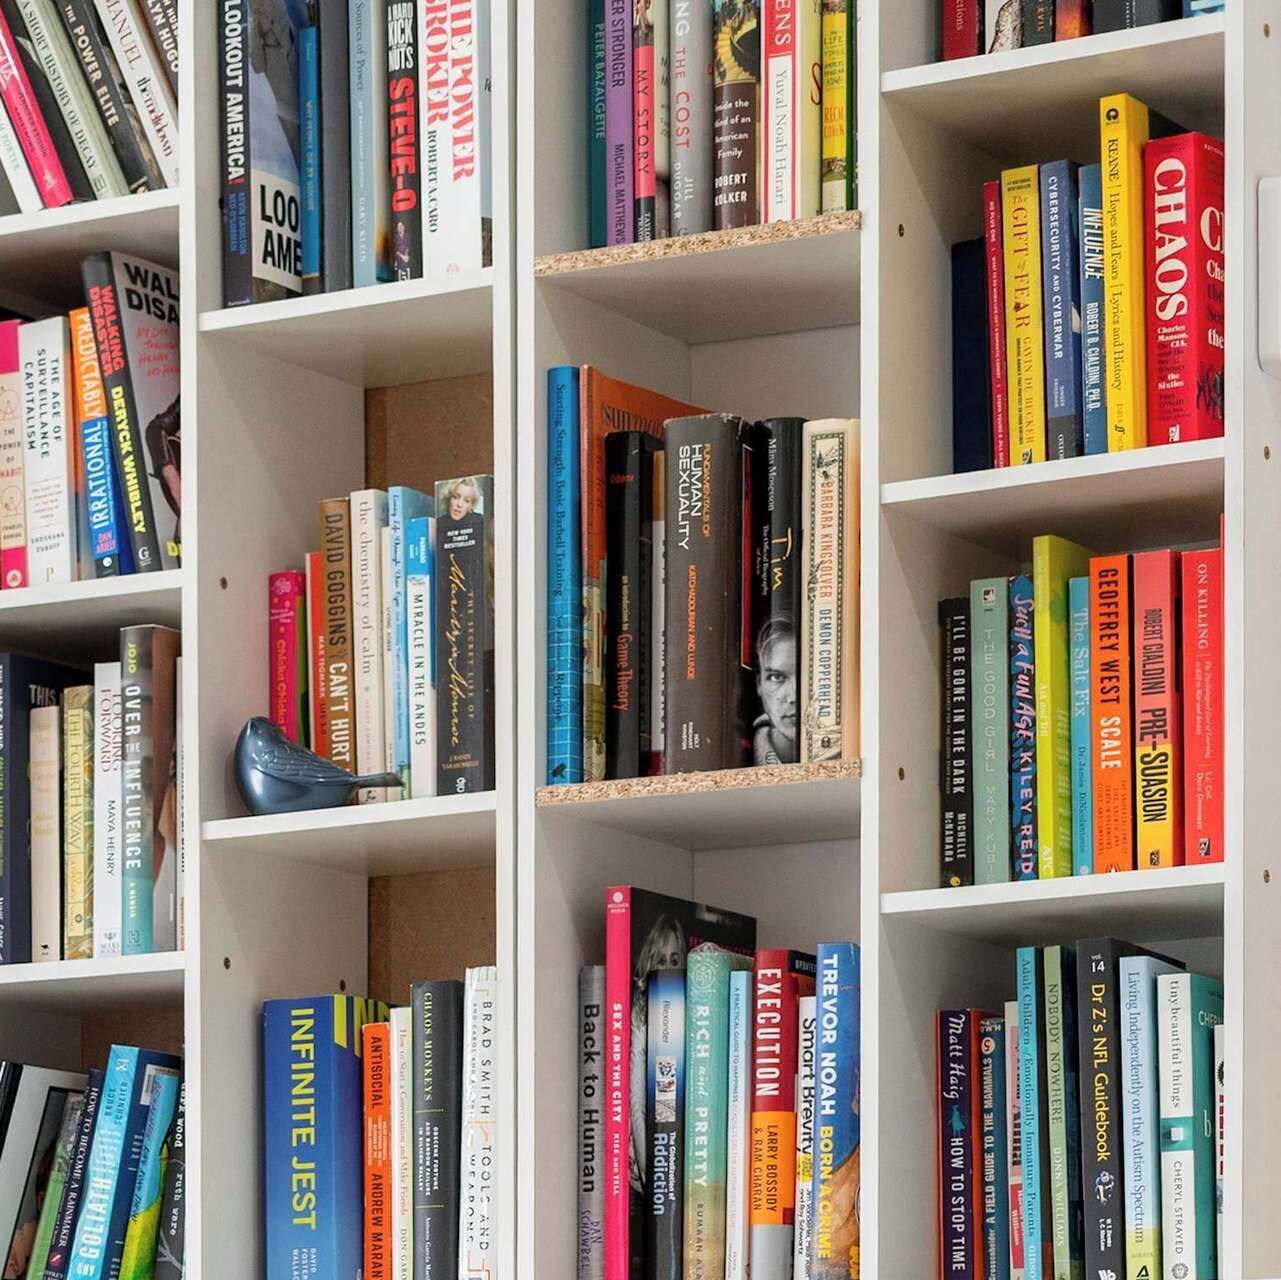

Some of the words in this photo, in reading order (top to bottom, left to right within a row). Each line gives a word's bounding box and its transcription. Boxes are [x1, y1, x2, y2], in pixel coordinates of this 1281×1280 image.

[22, 1, 32, 9] A
[24, 13, 48, 51] SHORT
[223, 0, 242, 87] LOOKOUT
[44, 55, 72, 108] HISTORY
[63, 4, 76, 23] THE
[72, 25, 102, 83] POWER
[97, 87, 121, 127] ELITE
[636, 69, 649, 96] MY
[674, 47, 687, 79] THE
[773, 69, 788, 109] Yuval
[67, 111, 80, 127] OF
[225, 92, 246, 185] AMERICA!
[451, 58, 475, 183] POWER
[637, 108, 650, 175] STORY
[675, 91, 691, 149] COST
[775, 113, 789, 153] Noah
[74, 130, 97, 169] DECAY
[389, 77, 417, 212] STEVE-O
[1107, 137, 1120, 182] KEANE
[775, 157, 789, 204] Harari
[1047, 176, 1060, 271] CYBERSECURITY
[1153, 156, 1188, 322] CHAOS
[1052, 274, 1060, 292] AND
[88, 287, 114, 377] DISASTER
[102, 285, 126, 371] WALKING
[1051, 295, 1064, 359] CYBERWAR
[50, 358, 61, 385] THE
[75, 312, 107, 420] PREDICTABLY
[24, 361, 36, 450] CAPITALISM
[36, 348, 51, 458] SURVEILLANCE
[51, 392, 62, 419] AGE
[51, 426, 62, 443] OF
[110, 385, 133, 454] DERYCK
[122, 455, 147, 534] WHIBLEY
[690, 444, 702, 517] HUMAN
[358, 501, 372, 524] the
[677, 445, 691, 550] SEXUALITY
[819, 481, 835, 529] BARBARA
[324, 513, 345, 564] DAVID
[352, 532, 374, 608] chemistry
[818, 532, 835, 599] KINGSOLVER
[1197, 563, 1208, 585] ON
[327, 571, 347, 646] GOGGINS
[360, 616, 376, 633] of
[412, 594, 425, 649] MIRACLE
[818, 608, 832, 645] DEMON
[1098, 568, 1120, 652] GEOFFREY
[1197, 588, 1209, 650] KILLING
[127, 642, 137, 674] JOJO
[361, 637, 374, 674] calm
[413, 656, 425, 668] IN
[616, 633, 633, 668] Game
[328, 662, 349, 711] CAN'T
[414, 674, 425, 697] THE
[613, 670, 634, 711] Theory
[817, 649, 832, 718] COPPERHEAD
[1100, 659, 1121, 705] WEST
[124, 685, 141, 744] OVER
[414, 704, 426, 746] ANDES
[330, 719, 350, 761] HURT
[1100, 716, 1122, 770] SCALE
[1139, 707, 1169, 823] PRE-SUASION
[105, 800, 116, 832] MAYA
[125, 760, 142, 869] INFLUENCE
[105, 836, 116, 876] HENRY
[423, 992, 433, 1035] CHAOS
[821, 953, 839, 1044] TREVOR
[1091, 984, 1106, 1003] Dr
[1167, 980, 1182, 1005] tiny
[582, 1004, 601, 1062] Back
[611, 1003, 623, 1030] SEX
[755, 967, 782, 1097] EXECUTION
[1092, 1007, 1107, 1033] Z's
[1170, 1006, 1182, 1065] beautiful
[423, 1039, 433, 1101] MONKEYS
[611, 1035, 623, 1061] AND
[1092, 1037, 1107, 1069] NFL
[290, 1007, 317, 1147] INFINITE
[370, 1036, 384, 1109] ANTISOCIAL
[583, 1073, 599, 1098] to
[611, 1064, 623, 1087] THE
[820, 1052, 838, 1116] NOAH
[1170, 1068, 1183, 1108] things
[86, 1087, 99, 1115] HOW
[611, 1090, 623, 1123] CITY
[1094, 1072, 1111, 1162] Guidebook
[82, 1118, 95, 1133] TO
[71, 1135, 90, 1180] BECOME
[582, 1108, 600, 1194] Human
[818, 1126, 834, 1179] BORN
[951, 1137, 965, 1168] HOW
[71, 1181, 79, 1189] A
[290, 1155, 317, 1230] JEST
[370, 1173, 384, 1227] ANDREW
[817, 1183, 833, 1196] A
[951, 1174, 965, 1192] TO
[57, 1192, 77, 1247] RAINMAKER
[817, 1199, 833, 1259] CRIME
[952, 1196, 965, 1233] STOP
[952, 1236, 966, 1271] TIME
